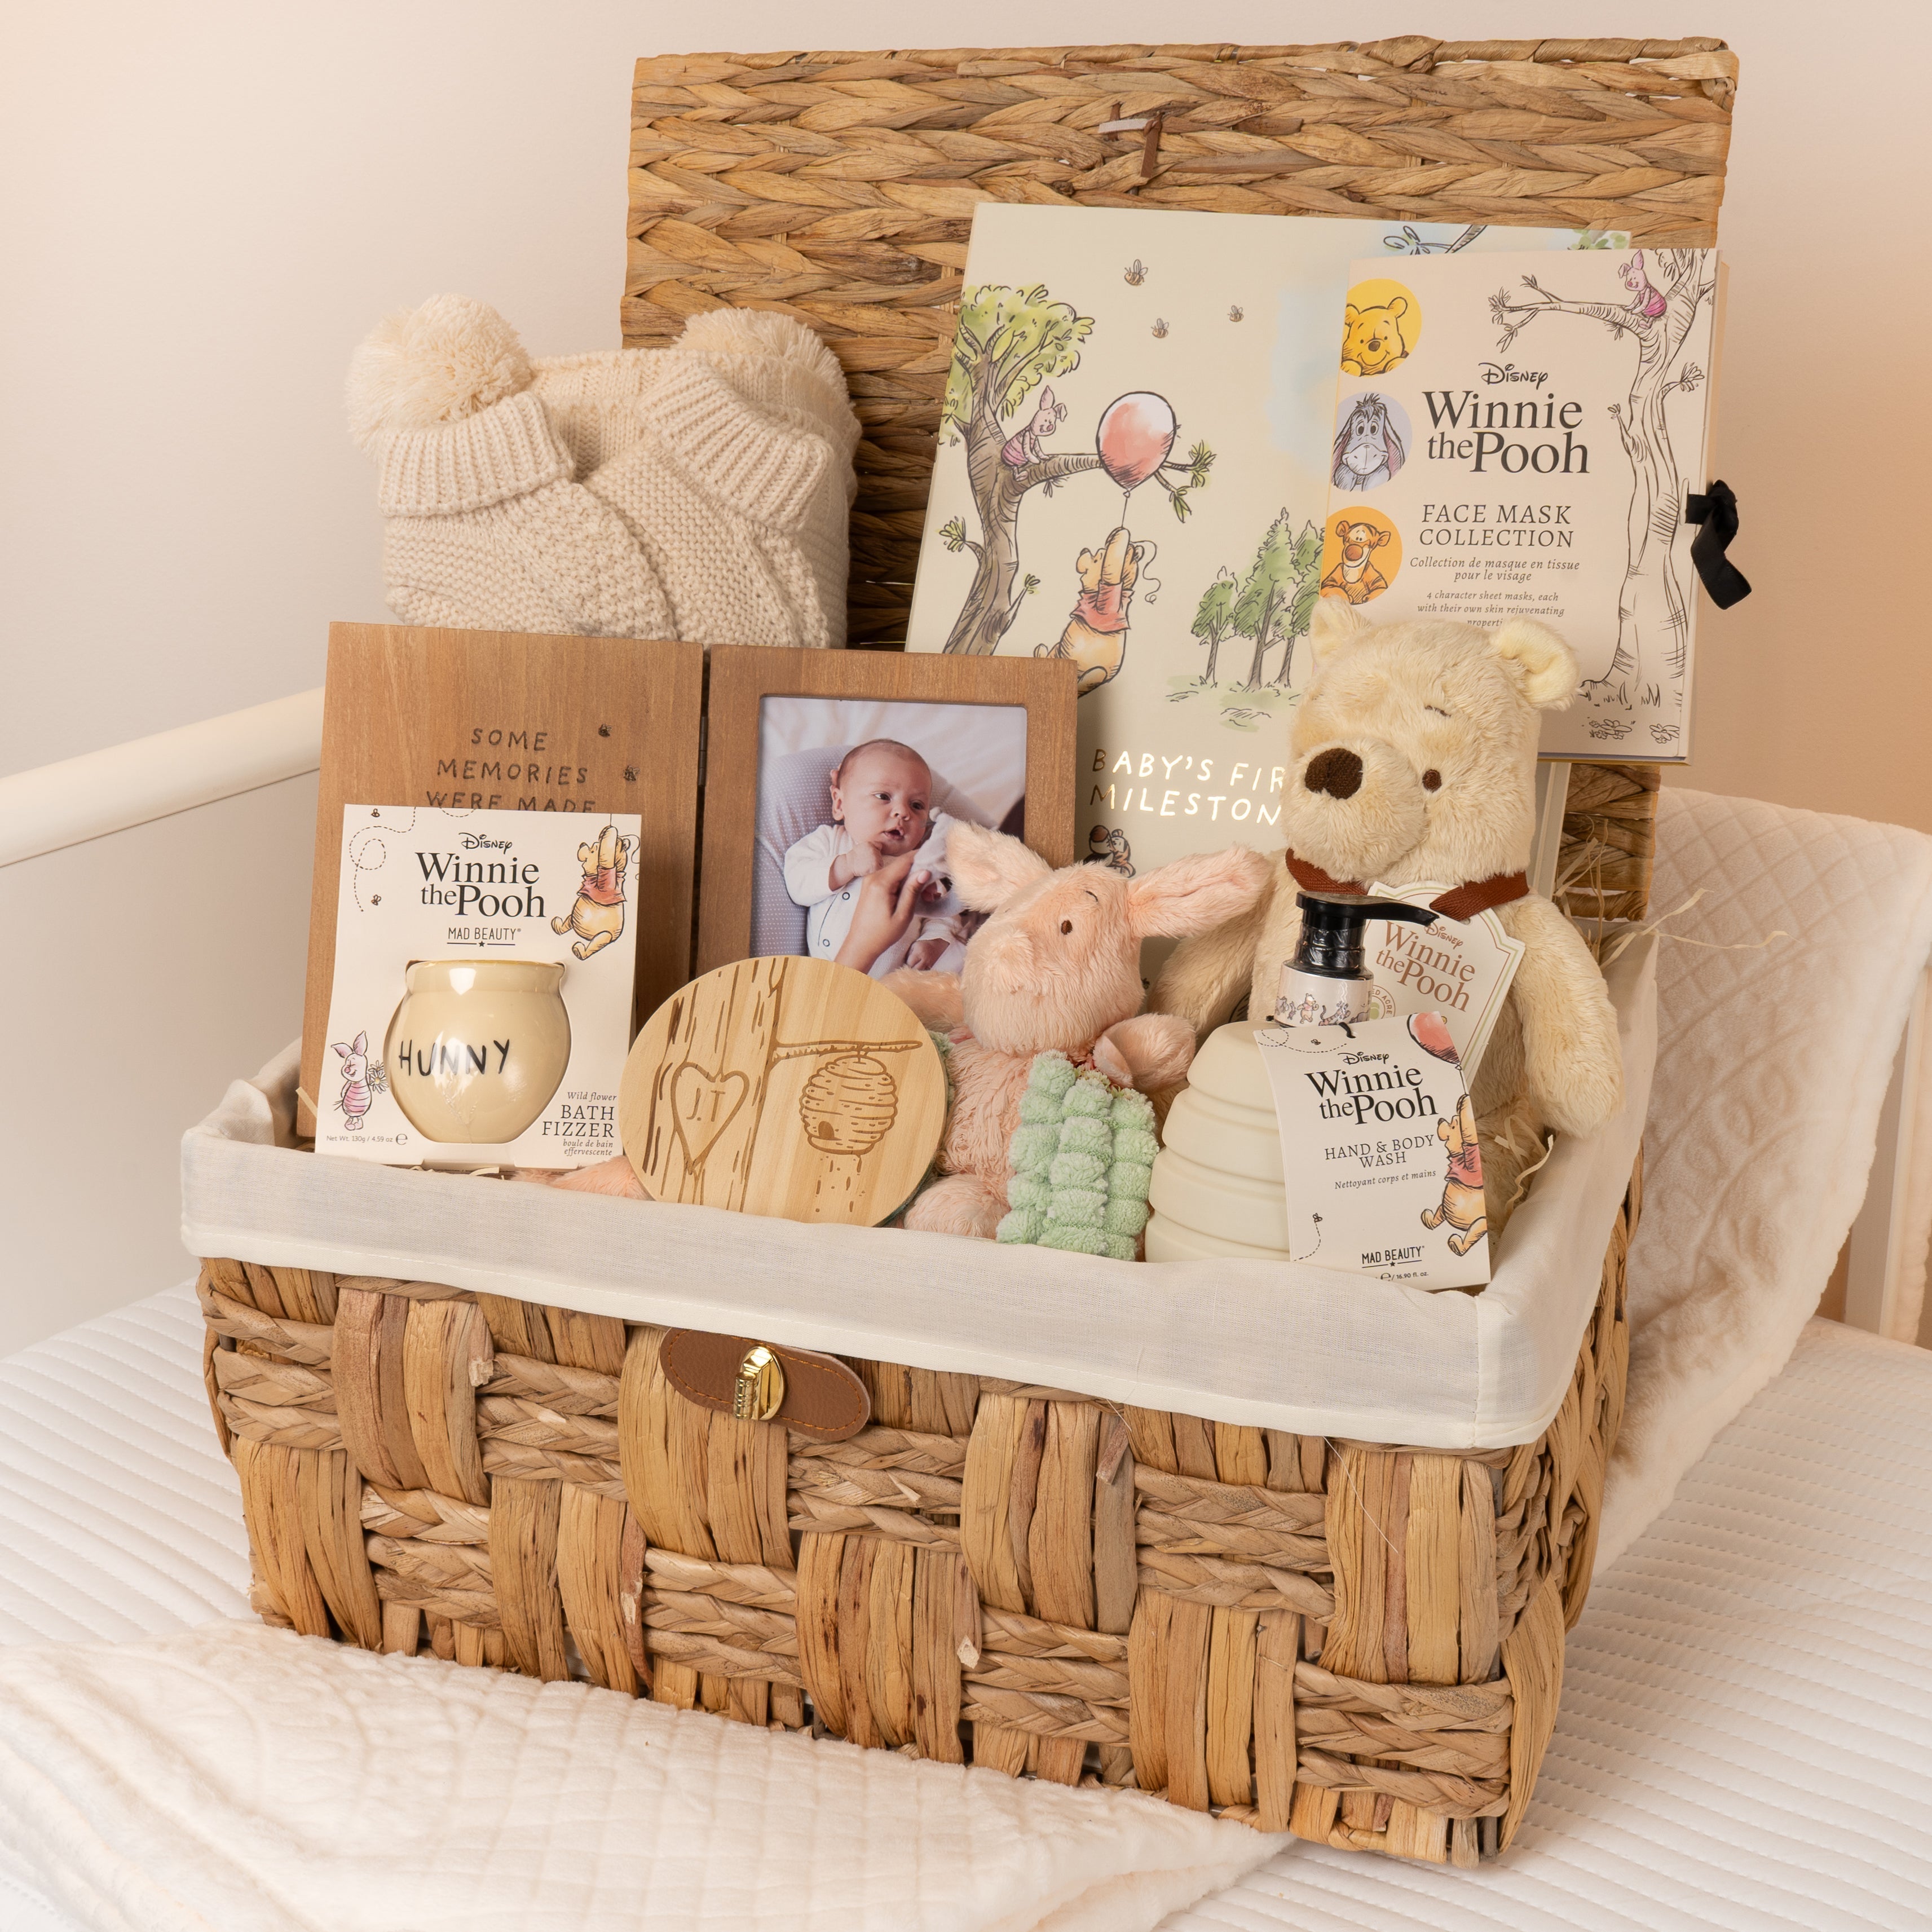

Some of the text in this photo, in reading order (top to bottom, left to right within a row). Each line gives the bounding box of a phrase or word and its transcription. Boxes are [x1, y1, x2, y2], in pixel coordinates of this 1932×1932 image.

[1422, 391, 1582, 429] Winnie
[1427, 431, 1590, 474] the Pooh
[1421, 504, 1572, 525] FACE MASK
[1419, 528, 1574, 548] COLLECTION
[1410, 556, 1581, 571] Collection de masque en tissue
[1453, 569, 1533, 584] pour le visage
[1434, 590, 1477, 600] character
[1479, 590, 1502, 601] sheet
[1505, 591, 1536, 603] masks,
[1538, 592, 1560, 602] each
[1417, 603, 1565, 617] with their own skin rejuvenating
[1467, 618, 1503, 628] roperti
[470, 727, 549, 752] SOME
[436, 758, 589, 786] MEMORIES
[1092, 748, 1287, 794] BABY'S FIR
[426, 790, 597, 813] WERE MADE
[1089, 783, 1282, 827] MILESTON
[414, 852, 540, 884] Winnie
[421, 883, 546, 918] the Pooh
[448, 927, 470, 940] MAD
[1385, 920, 1476, 982] Winnie
[1375, 950, 1470, 1012] the Pooh
[1382, 995, 1393, 1014] ACRE
[398, 1038, 510, 1078] HUNNY
[1304, 1065, 1424, 1098] Winnie
[567, 1091, 617, 1102] Wild flower
[1318, 1087, 1439, 1125] the Pooh
[561, 1104, 615, 1121] BATH
[542, 1121, 614, 1138] FIZZER
[563, 1139, 583, 1147] boule
[564, 1146, 612, 1157] effervescente
[1325, 1134, 1435, 1160] HAND & BODY
[1359, 1151, 1407, 1168] WASH
[1334, 1177, 1376, 1189] Nettoyant
[1378, 1174, 1399, 1185] corps
[1411, 1170, 1437, 1180] mains
[1361, 1251, 1382, 1264] MAD
